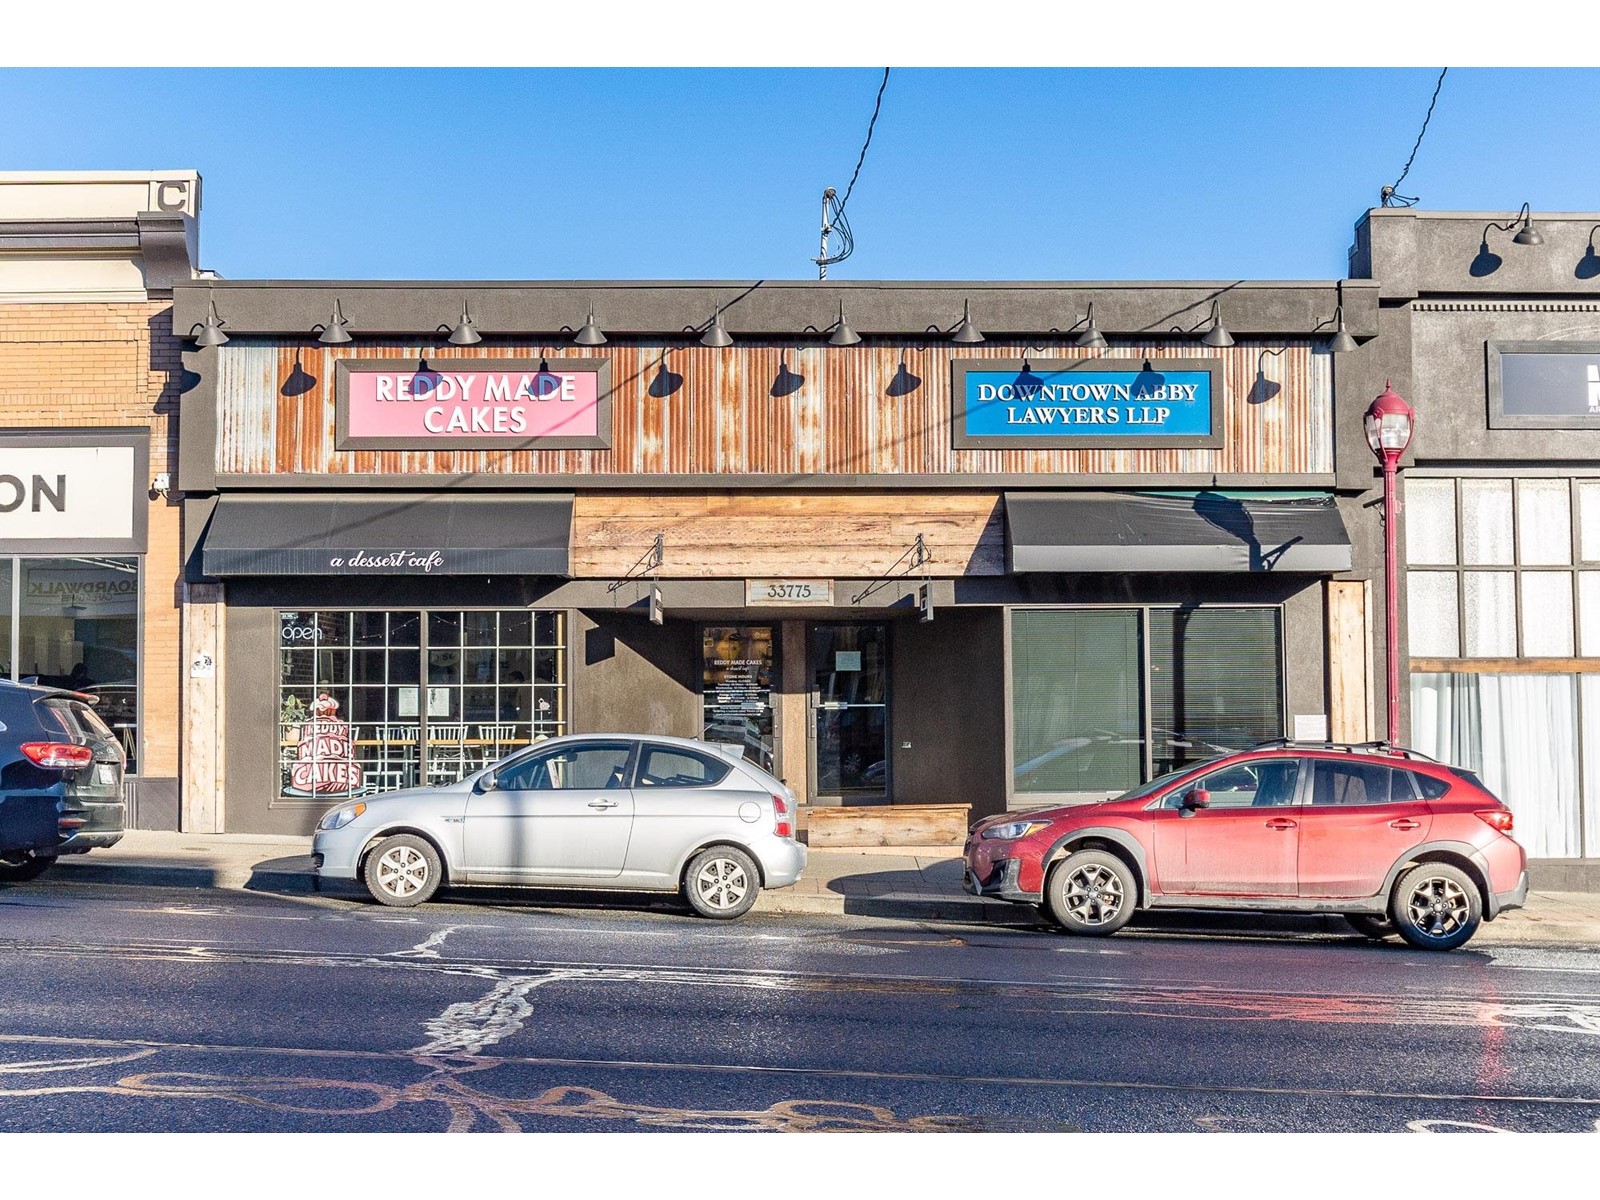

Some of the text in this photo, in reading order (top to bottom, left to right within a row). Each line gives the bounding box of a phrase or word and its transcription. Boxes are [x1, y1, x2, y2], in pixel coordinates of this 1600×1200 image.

[157, 180, 187, 212] C
[376, 375, 575, 401] REDDY MADE
[978, 384, 1198, 402] DOWNTOWN ABBY
[423, 406, 527, 433] CAKES
[1007, 407, 1170, 424] LAWYERS LLP
[330, 550, 444, 572] a dessert cafe
[768, 585, 811, 598] 33775
[282, 627, 322, 641] open
[295, 763, 358, 785] CAKES
